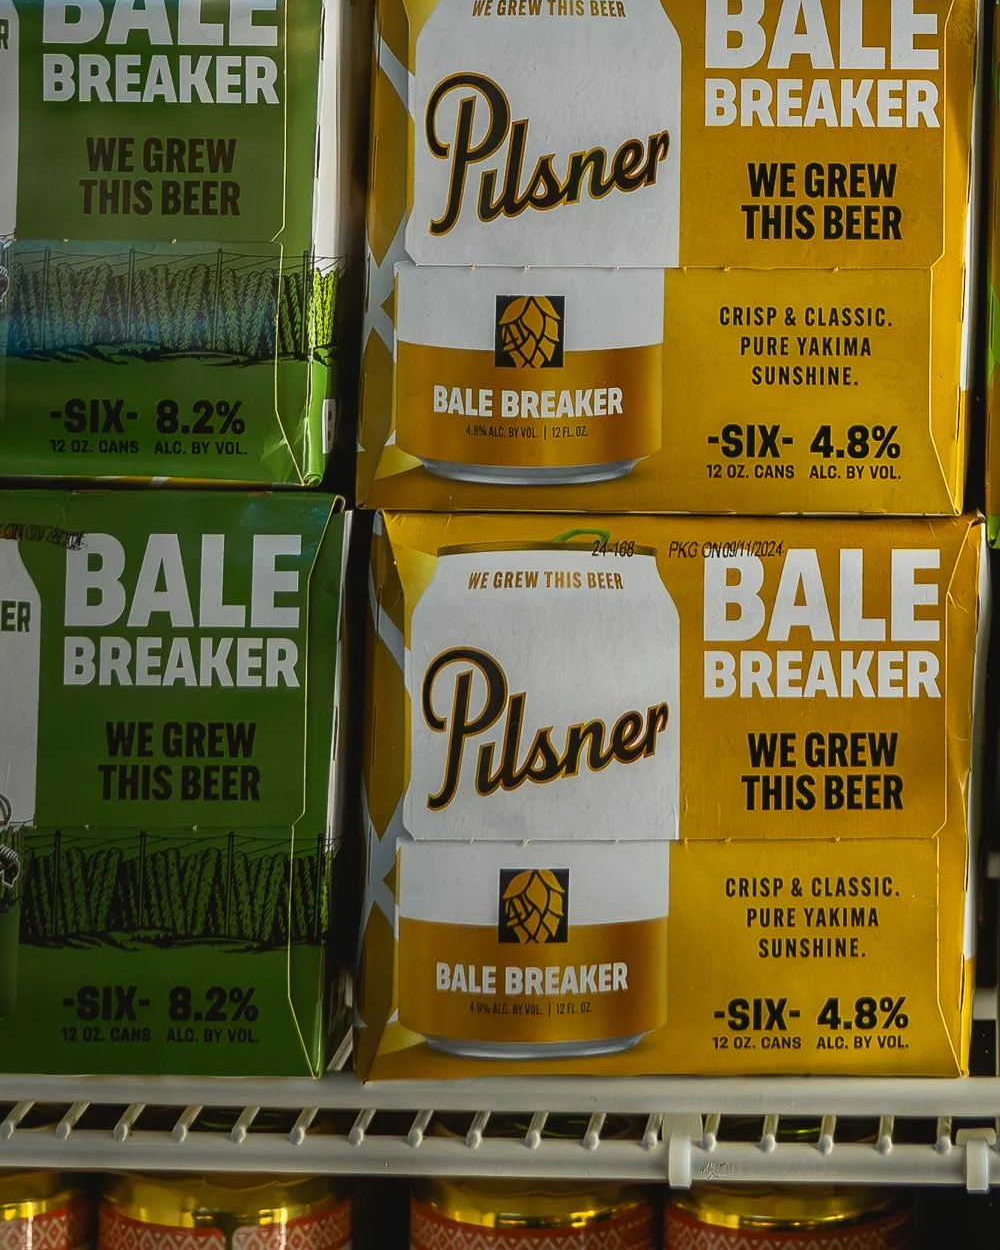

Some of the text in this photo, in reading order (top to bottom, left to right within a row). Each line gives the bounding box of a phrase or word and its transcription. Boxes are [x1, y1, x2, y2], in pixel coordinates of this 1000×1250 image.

[472, 0, 626, 18] WE GREW THIS BEER
[42, 54, 279, 105] BREAKER
[704, 79, 940, 129] BREAKER
[87, 137, 236, 173] WE GREW
[425, 71, 670, 236] Pilsner
[79, 179, 241, 216] THIS BEER
[748, 163, 897, 198] WE GREW
[741, 205, 902, 240] THIS BEER
[719, 307, 892, 327] CRISP & CLASSIC.
[740, 337, 872, 356] PURE YAKIMA
[752, 367, 858, 386] SUNSHINE.
[156, 400, 245, 435] 8.2%
[433, 385, 623, 418] BALE BREAKER
[810, 425, 901, 460] 4.8%
[706, 465, 901, 480] 12 OZ. CANS ALC. BY VOL.
[669, 541, 697, 558] PKG
[64, 533, 301, 629] BALE
[703, 548, 941, 642] BALE
[63, 637, 299, 687] BREAKER
[704, 650, 941, 698] BREAKER
[422, 646, 669, 812] Pilsner
[817, 997, 909, 1030] 4.8%
